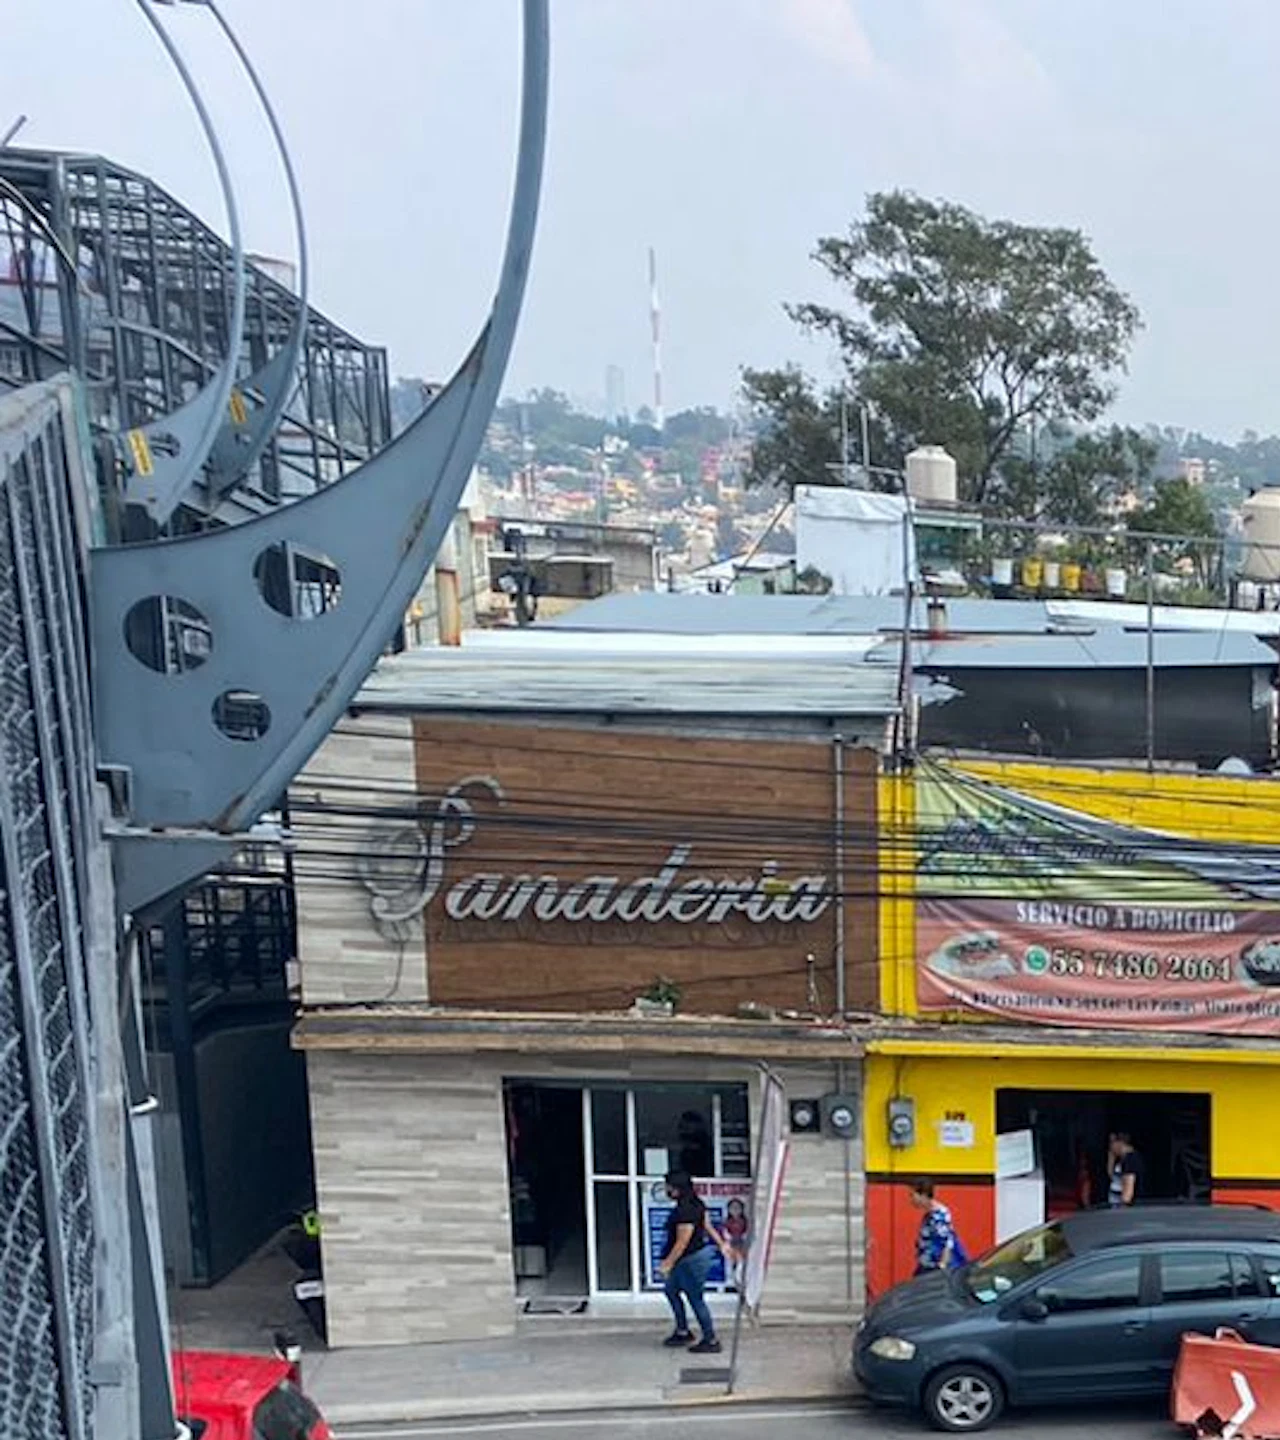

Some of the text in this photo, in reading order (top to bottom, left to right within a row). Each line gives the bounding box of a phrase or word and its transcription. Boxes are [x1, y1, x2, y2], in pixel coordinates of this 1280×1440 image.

[1016, 901, 1236, 933] SERVICIO A DOMICILIO
[1051, 949, 1084, 977] 55
[1165, 953, 1233, 983] 2664
